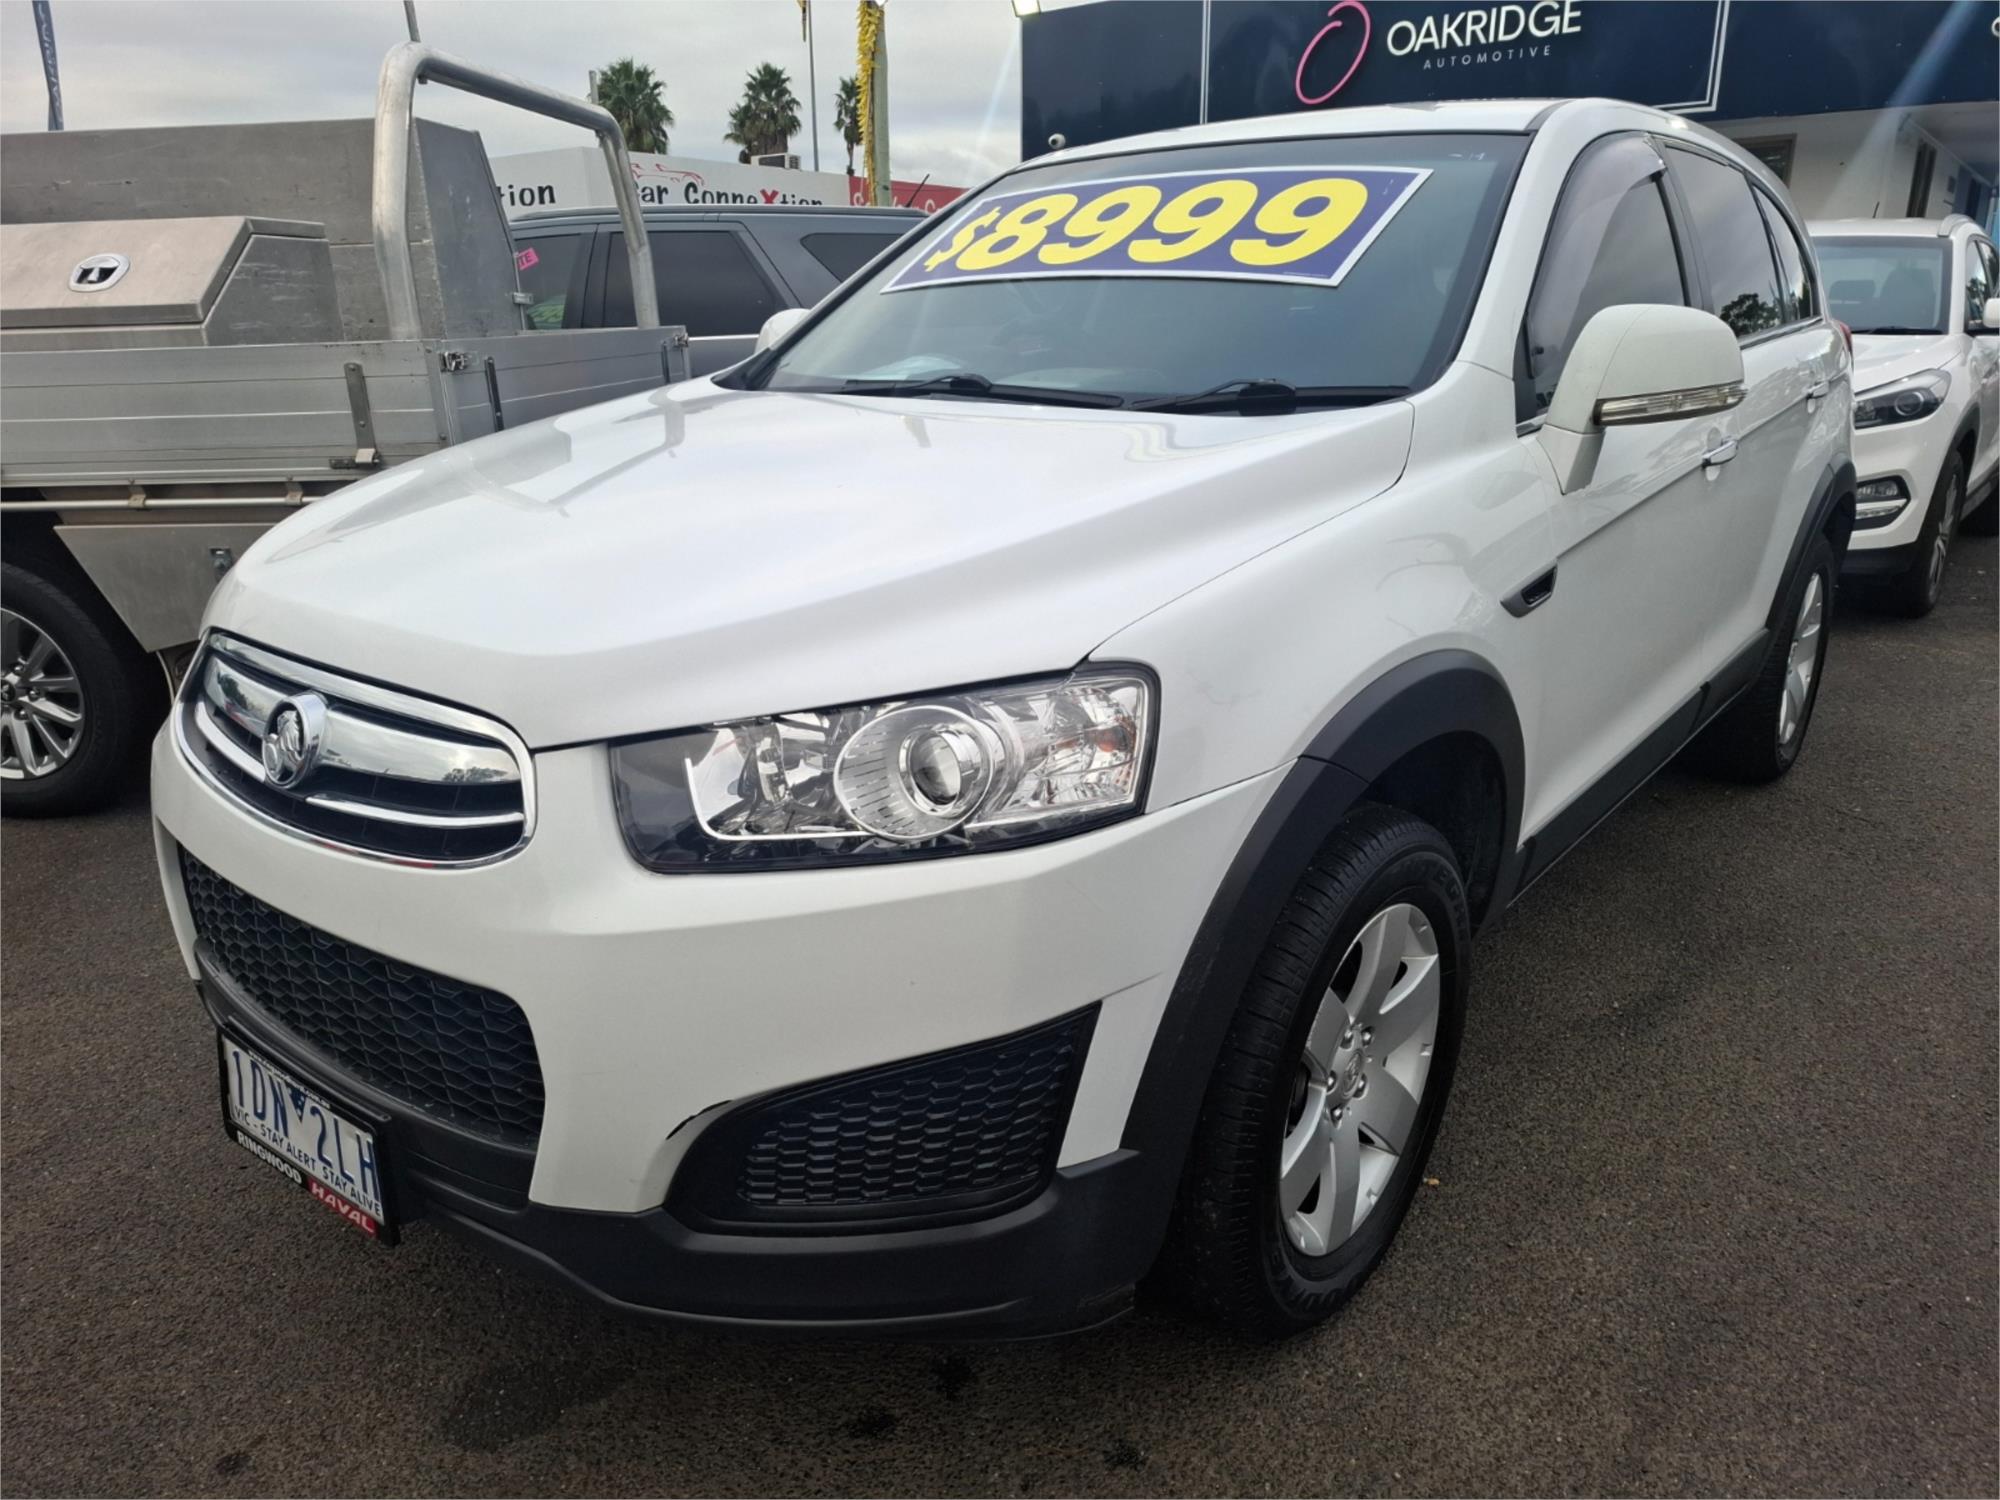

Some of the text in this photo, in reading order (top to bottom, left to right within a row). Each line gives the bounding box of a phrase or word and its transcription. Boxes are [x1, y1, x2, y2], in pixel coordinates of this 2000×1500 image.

[1387, 0, 1582, 56] OAKRIDGE
[1423, 45, 1551, 70] AUTOMOTIVE
[924, 177, 1368, 272] $8999
[237, 1131, 375, 1233] RINGWOOD HAVAL
[261, 1124, 285, 1149] STAY
[286, 1142, 316, 1170] ALERT
[323, 1167, 348, 1190] STAY
[350, 1186, 381, 1216] ALIVE
